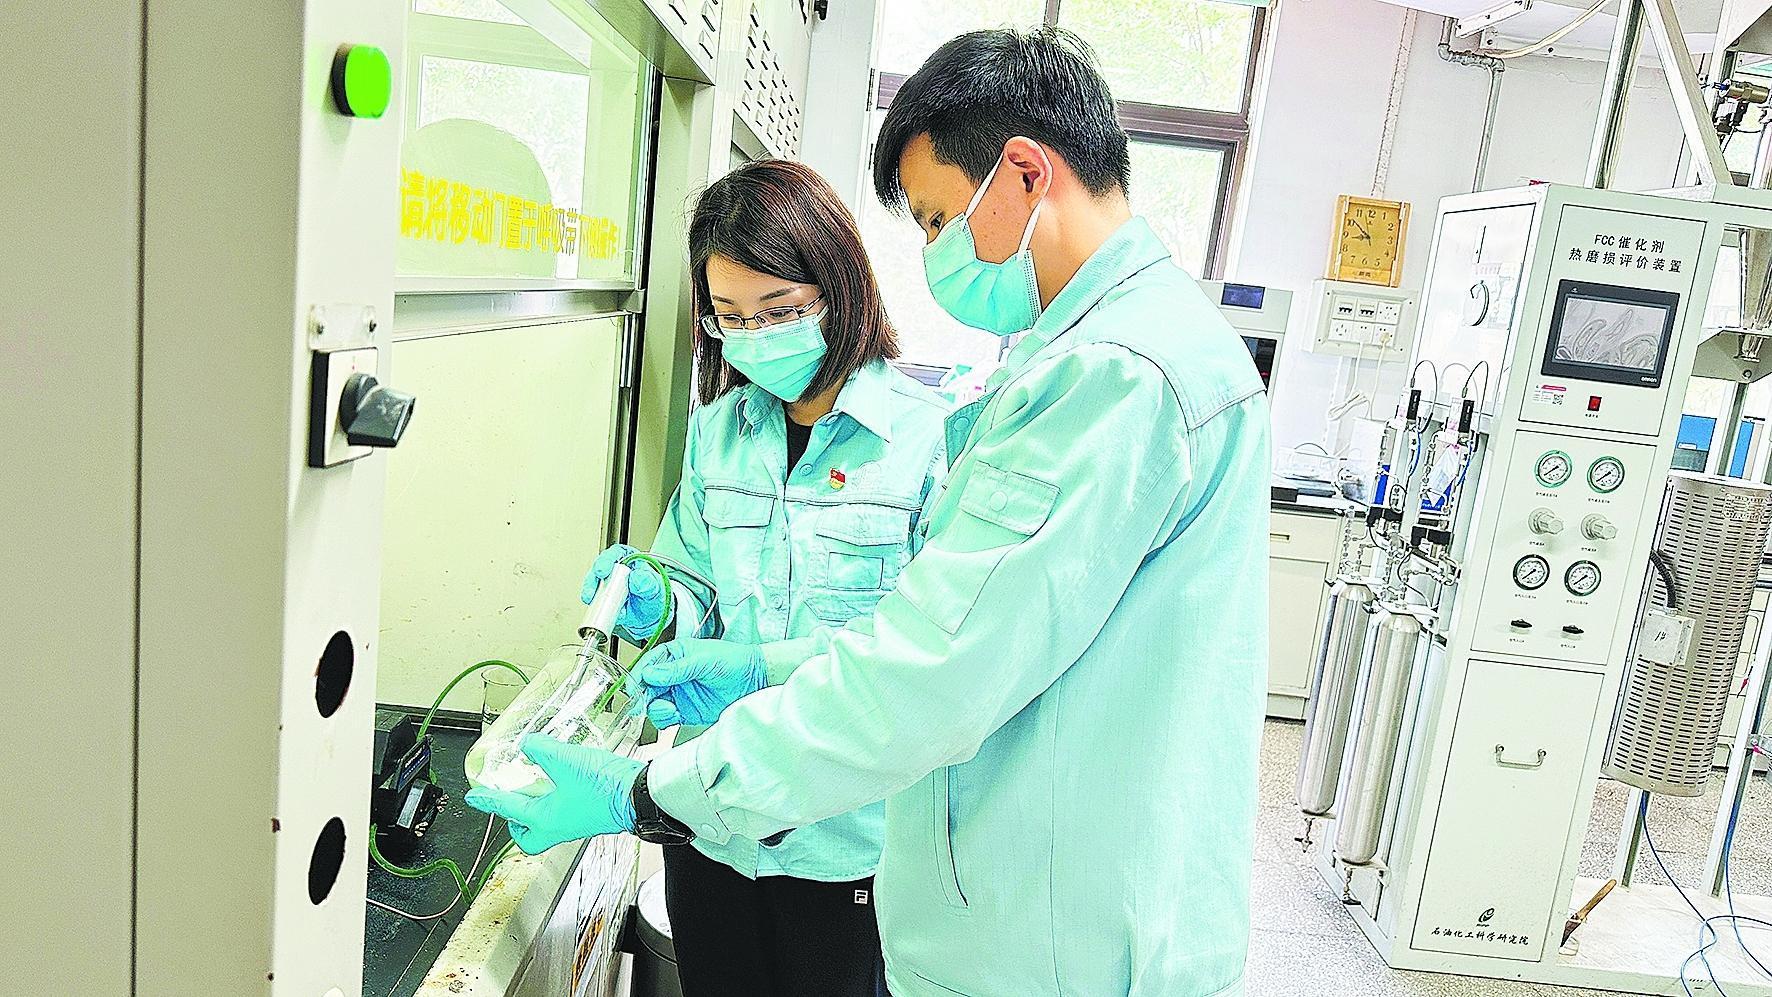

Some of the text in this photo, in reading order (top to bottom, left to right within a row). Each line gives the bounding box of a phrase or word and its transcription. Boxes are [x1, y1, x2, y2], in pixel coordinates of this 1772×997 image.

[1356, 209, 1363, 218] 11
[1368, 209, 1376, 218] 12
[1382, 211, 1387, 220] 1
[1347, 218, 1355, 227] 10
[1387, 222, 1394, 231] 2
[1343, 231, 1349, 239] 9
[1387, 236, 1393, 245] 3
[1594, 234, 1665, 253] FCC 催化剂
[1342, 244, 1348, 252] 8
[1384, 249, 1389, 257] 4
[1350, 255, 1356, 263] 7
[1361, 256, 1368, 265] 6
[1374, 258, 1380, 267] 5
[1568, 247, 1683, 273] 热磨损评价装置
[1431, 927, 1529, 946] 石油化工科学研究院
